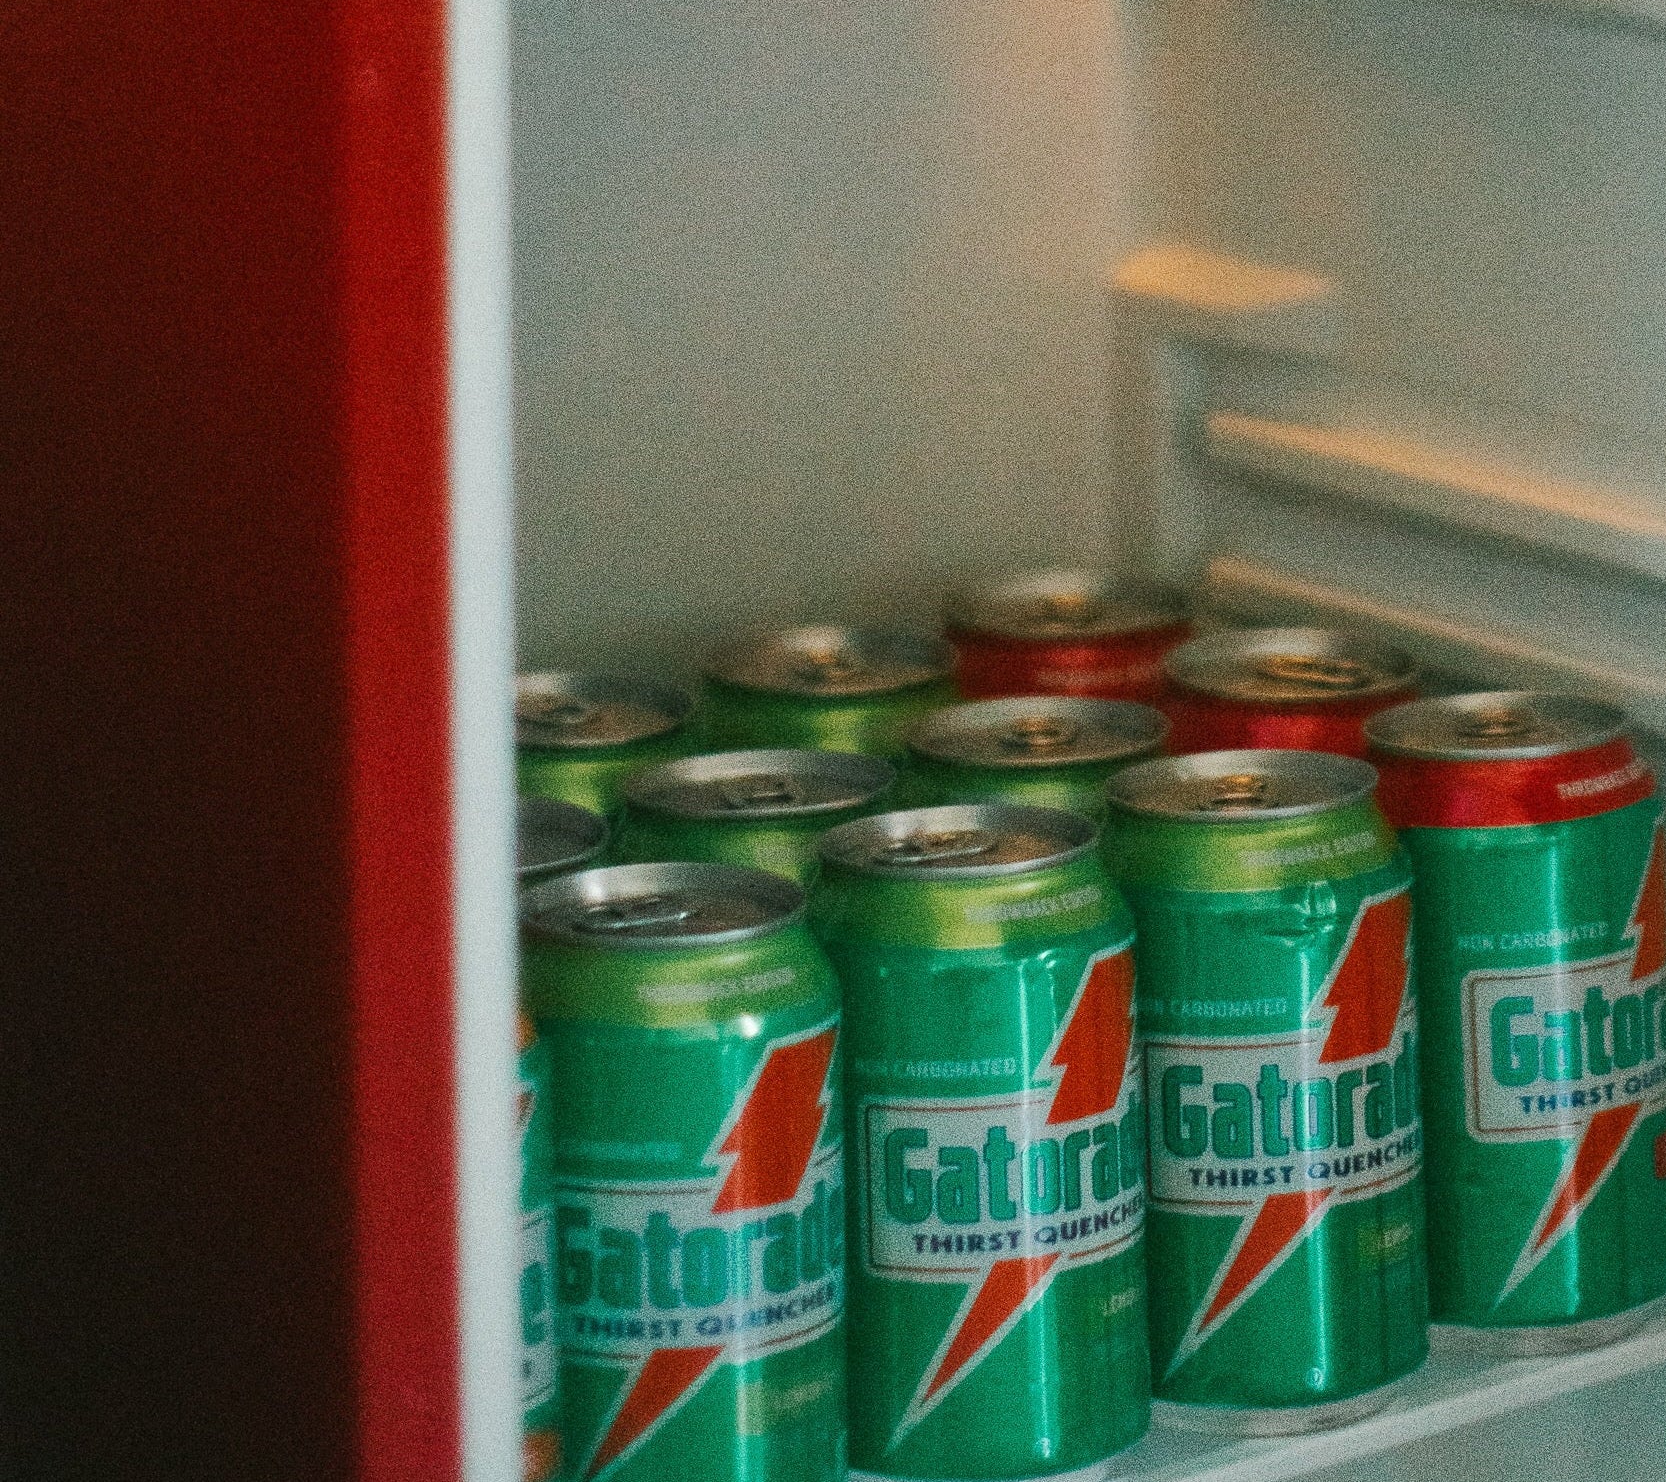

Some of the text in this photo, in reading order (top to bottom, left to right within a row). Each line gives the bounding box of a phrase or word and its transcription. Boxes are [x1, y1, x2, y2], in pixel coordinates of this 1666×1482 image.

[1161, 1031, 1414, 1159] Gatorad
[1521, 1083, 1616, 1115] THIRST
[884, 1090, 1146, 1225] Gatorad
[1190, 1165, 1294, 1188] THIRST
[913, 1230, 1021, 1254] THIRST
[575, 1314, 682, 1339] THIRST
